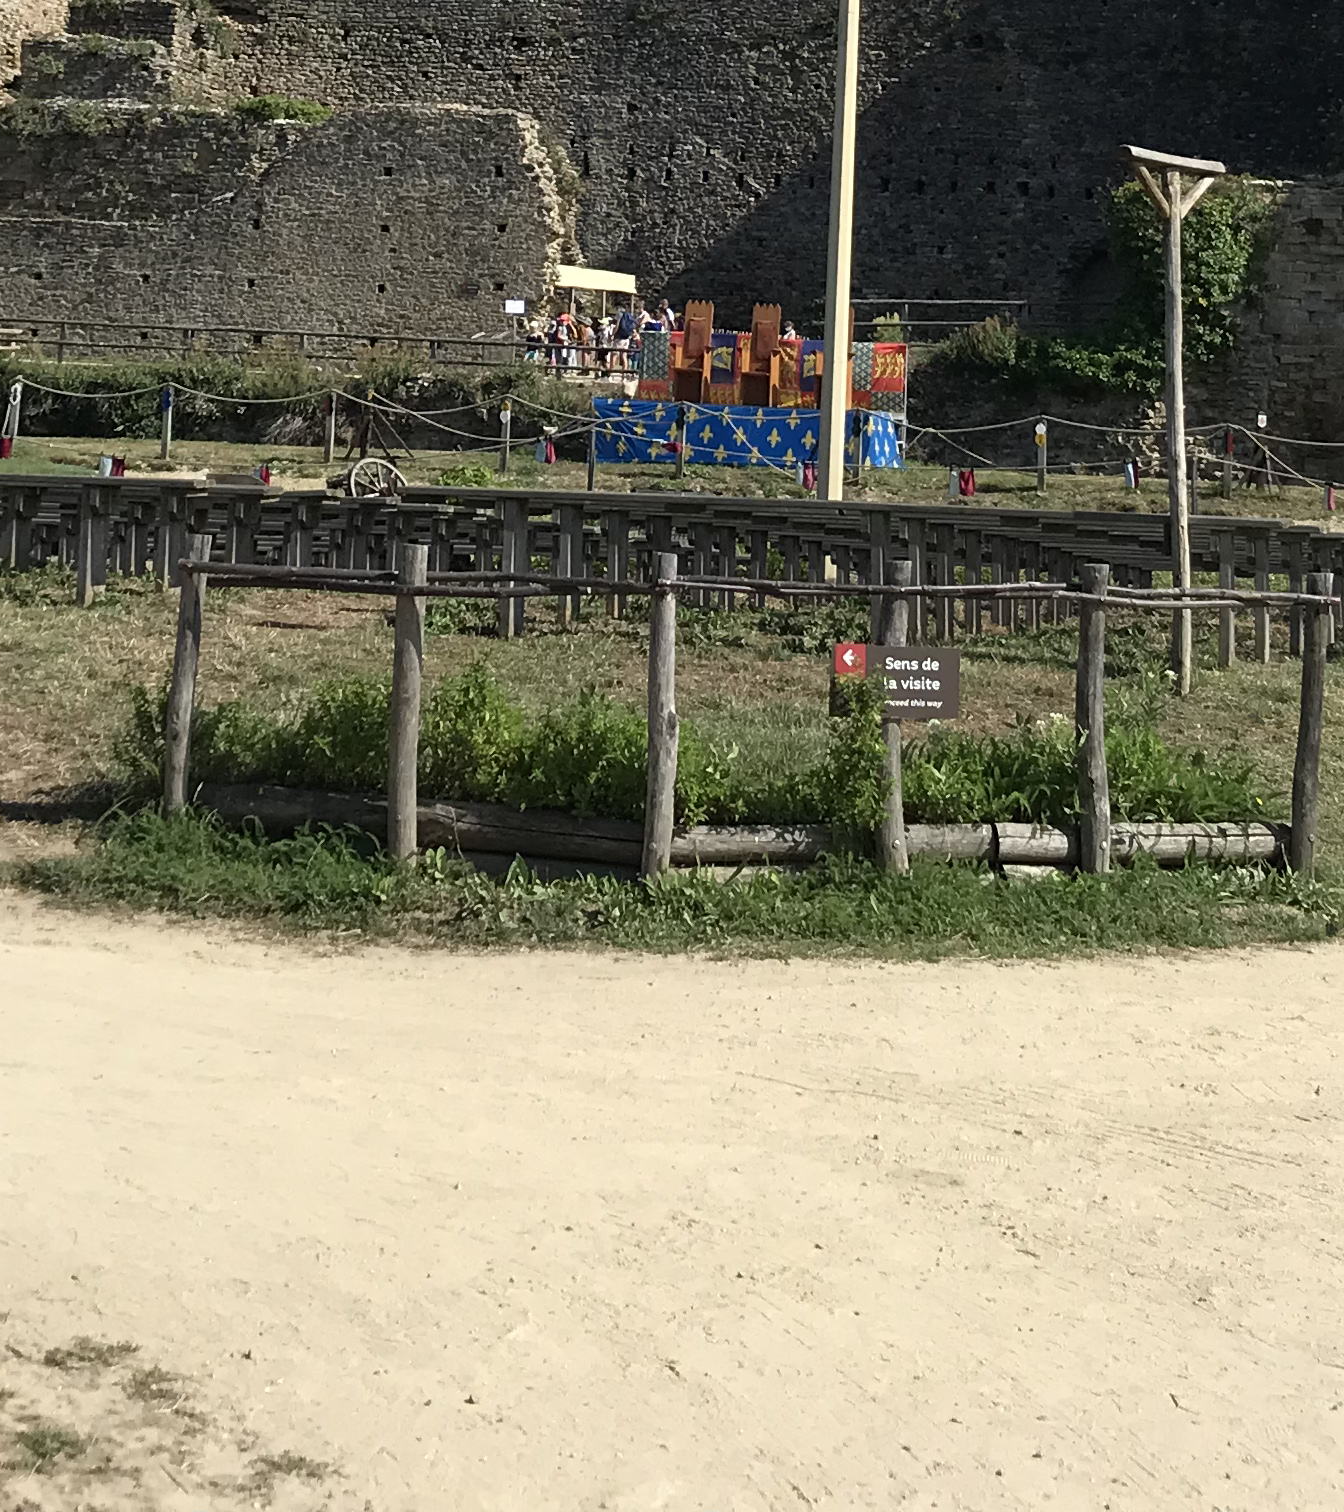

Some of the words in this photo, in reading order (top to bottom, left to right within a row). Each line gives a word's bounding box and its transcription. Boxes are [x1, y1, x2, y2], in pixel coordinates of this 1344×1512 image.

[885, 657, 918, 670] Sens
[922, 657, 940, 671] de
[883, 676, 897, 690] la
[901, 676, 940, 690] visite
[910, 699, 925, 707] this
[927, 700, 943, 708] way
